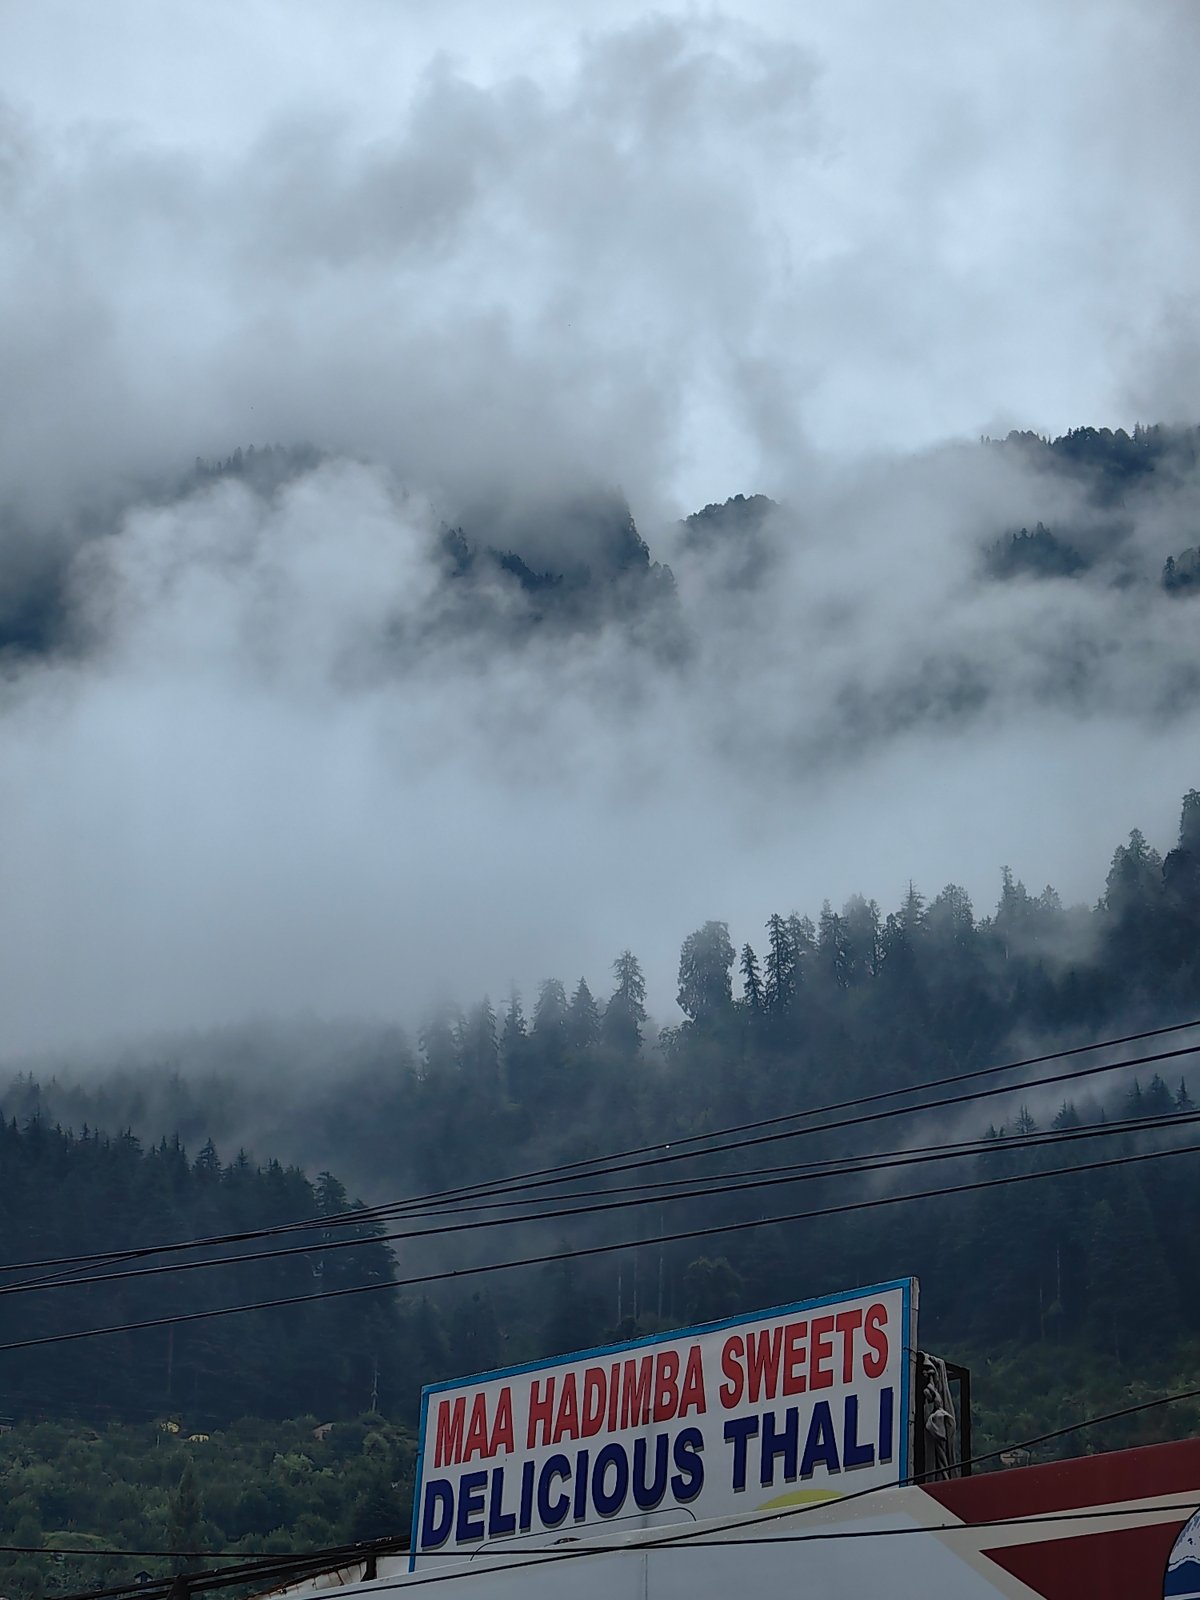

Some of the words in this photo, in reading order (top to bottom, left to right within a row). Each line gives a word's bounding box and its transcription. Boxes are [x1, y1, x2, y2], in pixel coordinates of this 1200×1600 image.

[434, 1386, 514, 1468] MAA
[526, 1346, 706, 1449] HADIMBA
[719, 1303, 889, 1409] SWEETS
[421, 1427, 704, 1550] DELICIOUS
[724, 1387, 893, 1492] THALI
